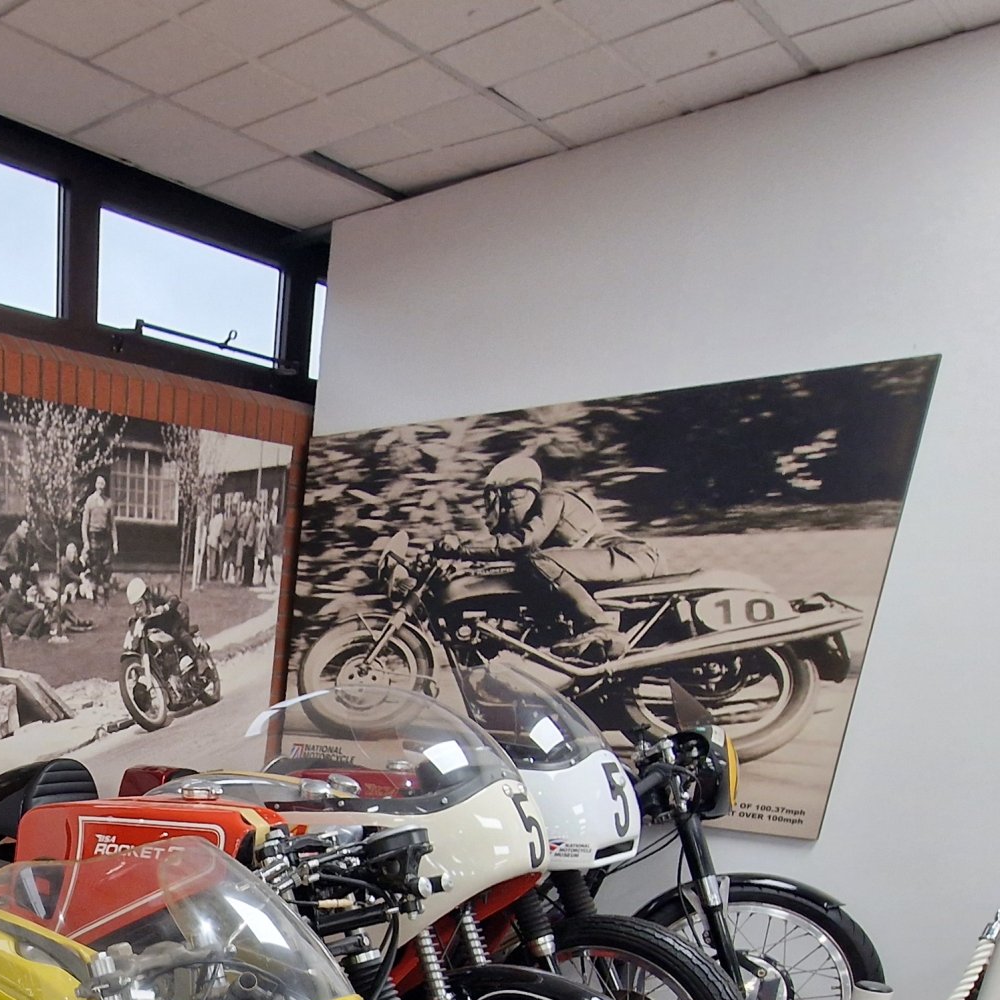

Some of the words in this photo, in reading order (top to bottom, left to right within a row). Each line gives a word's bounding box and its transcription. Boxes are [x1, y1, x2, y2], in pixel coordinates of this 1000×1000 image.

[713, 597, 776, 625] 10
[304, 743, 343, 755] NATIONAL
[600, 762, 630, 838] 5
[738, 810, 764, 820] OVER
[767, 813, 804, 825] 100mph
[739, 802, 753, 810] OF
[755, 804, 806, 817] 100.37mph
[511, 792, 546, 868] 5
[95, 834, 117, 844] BSA
[93, 843, 166, 861] ROCKET
